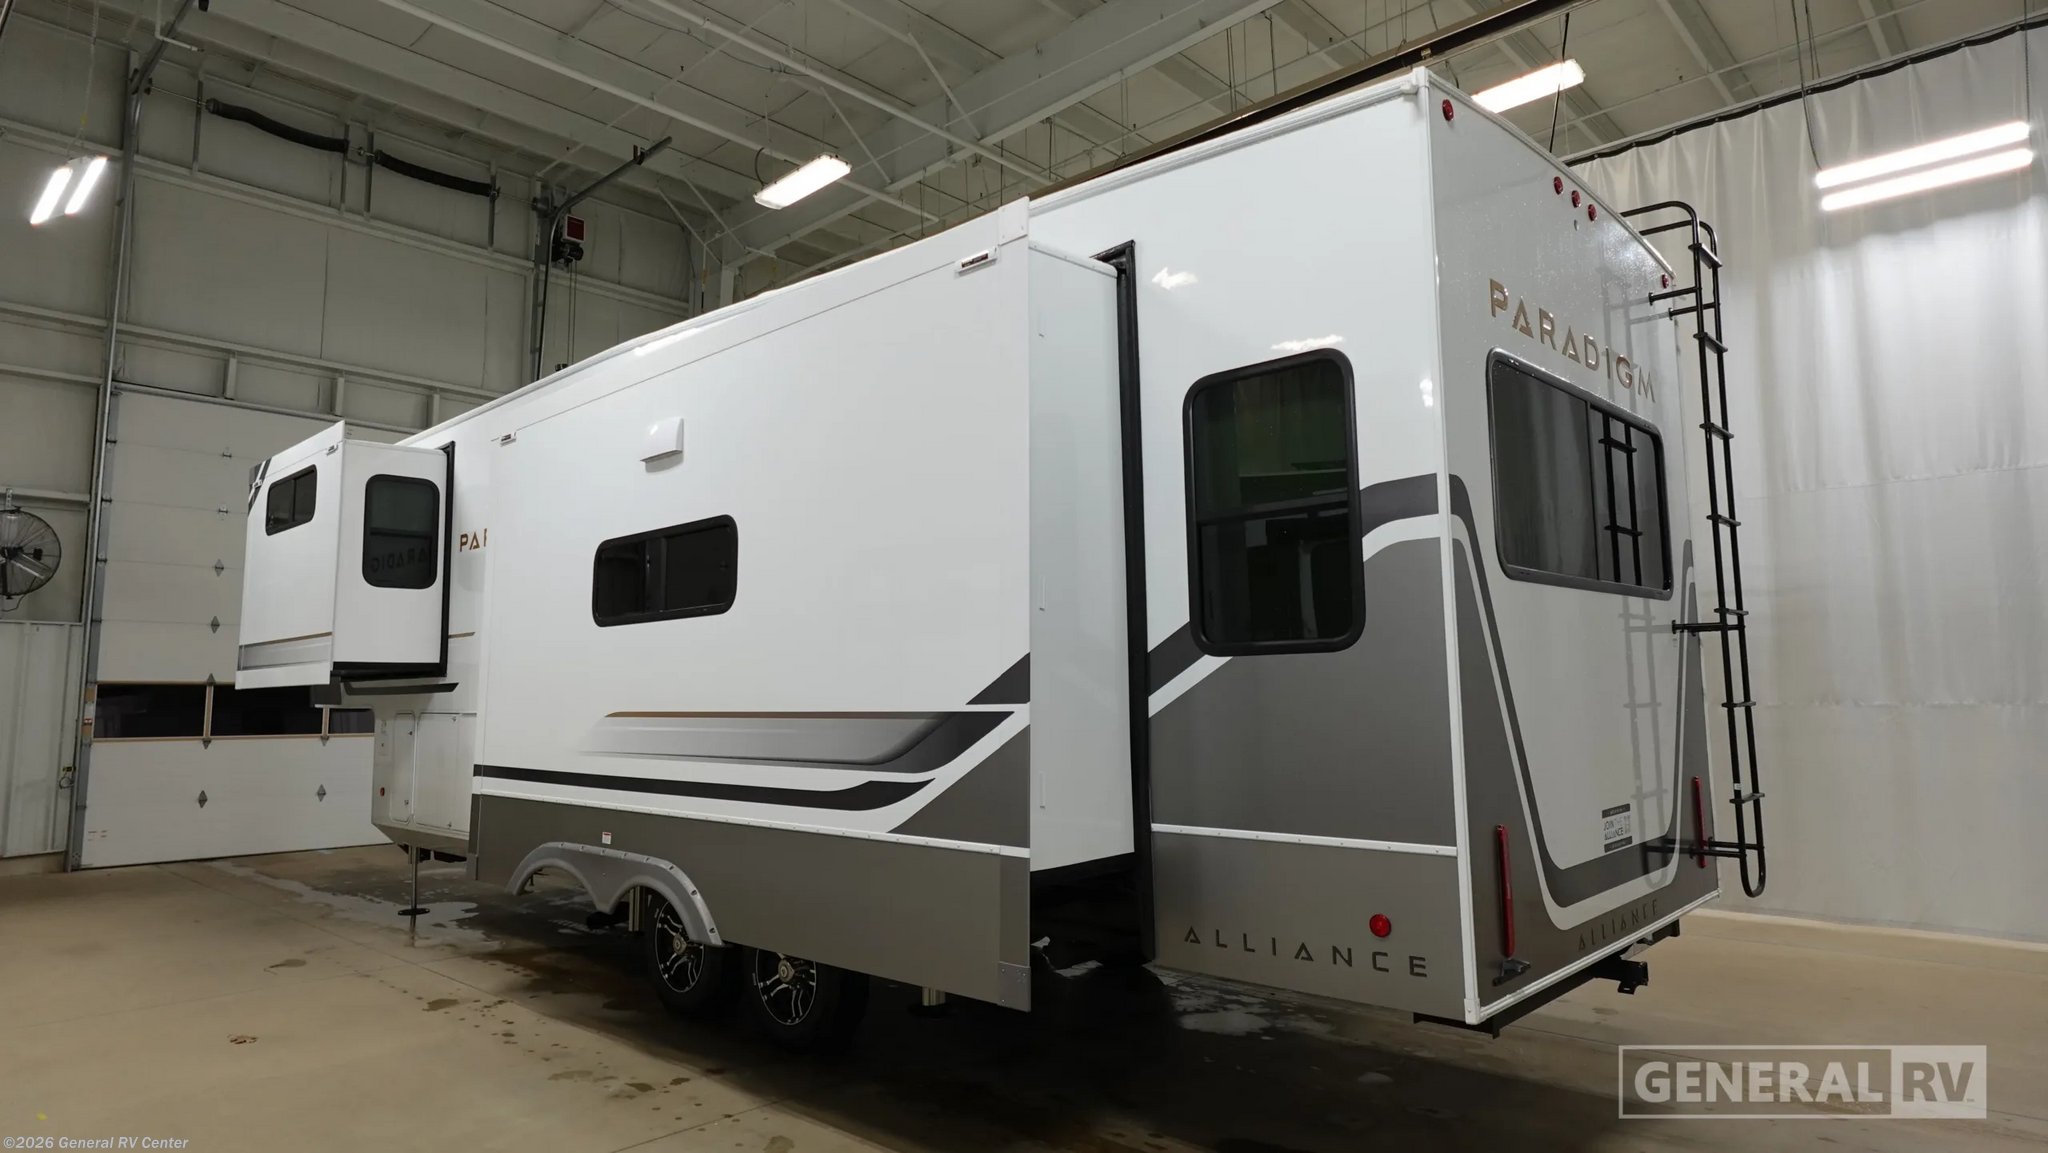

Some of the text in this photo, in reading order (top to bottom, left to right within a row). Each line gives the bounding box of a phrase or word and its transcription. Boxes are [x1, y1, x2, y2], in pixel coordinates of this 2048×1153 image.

[1489, 277, 1656, 403] PARADIGM
[1578, 899, 1658, 951] ALLIANCE
[1184, 926, 1428, 978] ALLIANCE
